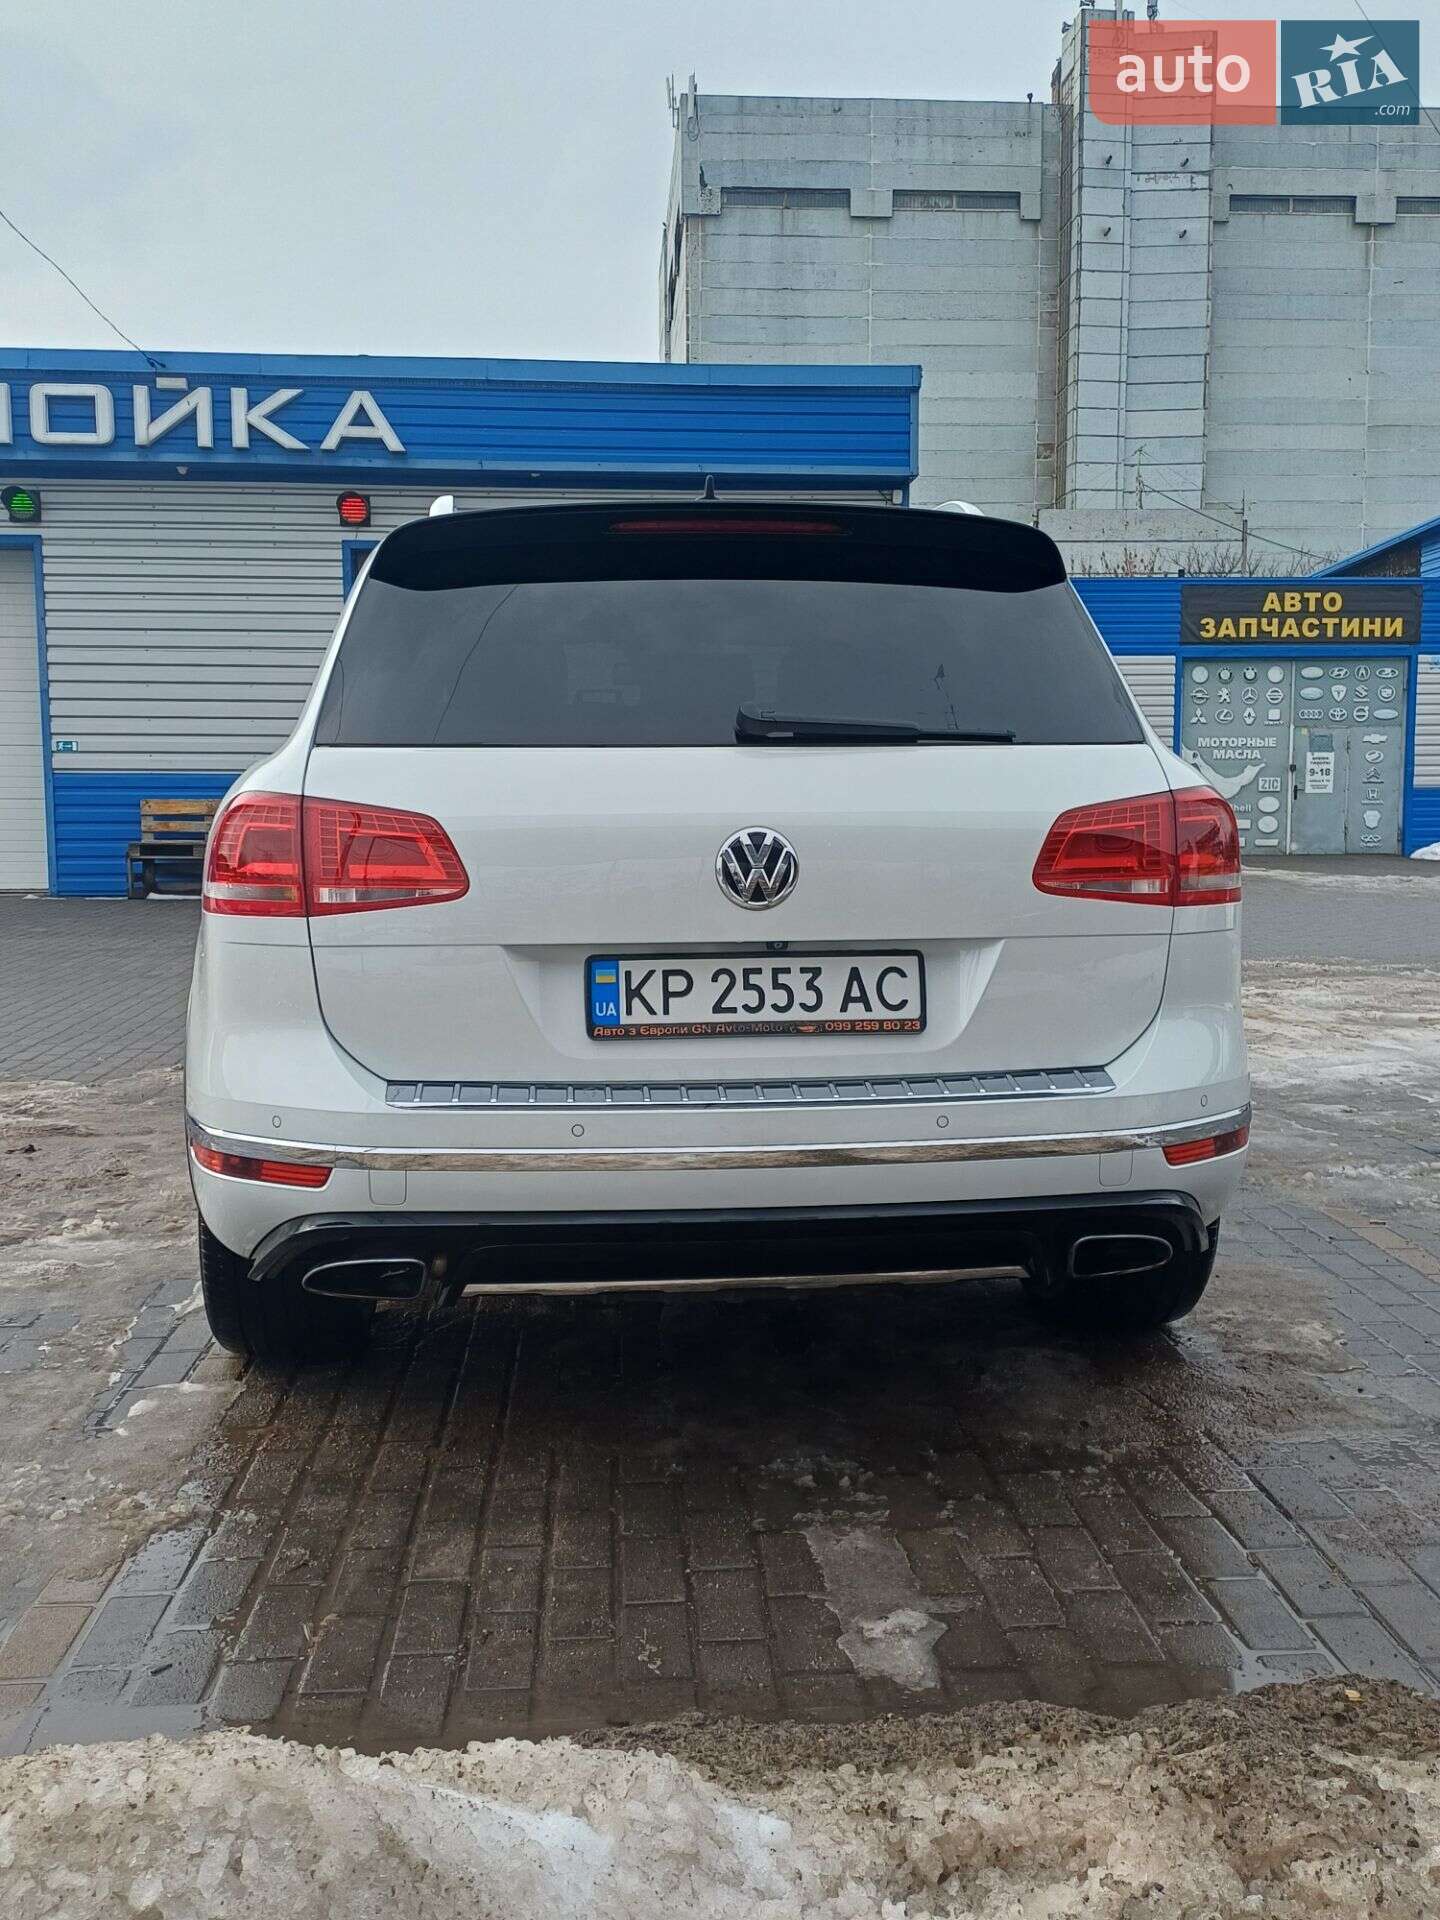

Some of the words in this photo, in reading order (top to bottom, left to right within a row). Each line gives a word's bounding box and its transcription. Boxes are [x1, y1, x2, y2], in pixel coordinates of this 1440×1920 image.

[1262, 592, 1343, 613] АВТО
[1200, 617, 1404, 638] ЗАПЧАСТИНИ
[1198, 737, 1277, 748] МОТОРНЫЕ
[1213, 749, 1262, 760] МАСЛА
[1309, 768, 1331, 776] 9-18
[1260, 778, 1279, 790] ZIC
[1232, 802, 1251, 812] hell
[624, 969, 694, 1017] KP
[711, 966, 823, 1015] 2553
[839, 966, 909, 1013] AC
[596, 1002, 617, 1017] UA
[594, 1026, 625, 1037] Авто
[692, 1024, 712, 1034] GN
[825, 1020, 851, 1031] 099
[855, 1020, 880, 1031] 259
[883, 1020, 900, 1030] 80
[904, 1020, 921, 1030] 23
